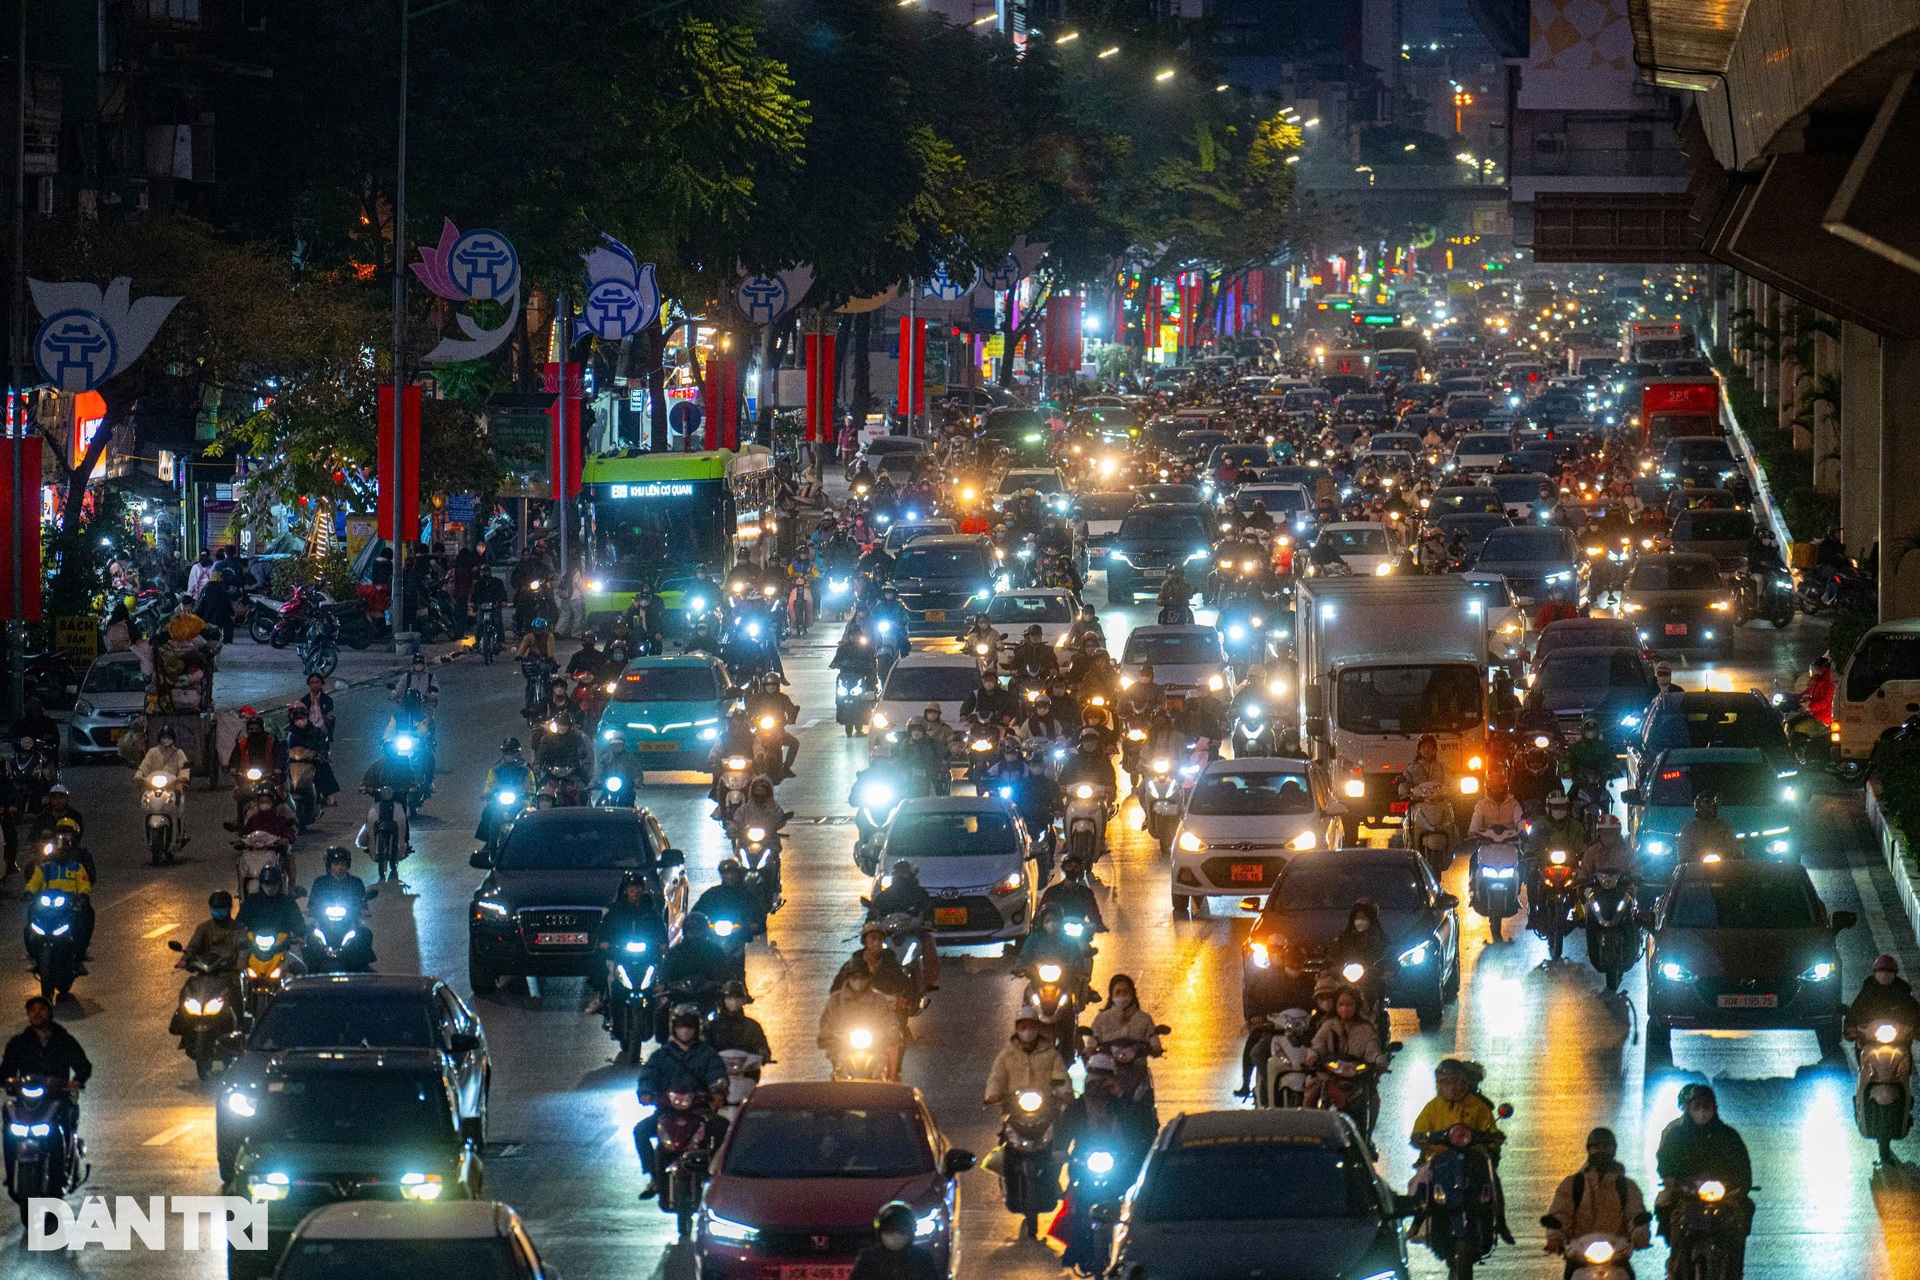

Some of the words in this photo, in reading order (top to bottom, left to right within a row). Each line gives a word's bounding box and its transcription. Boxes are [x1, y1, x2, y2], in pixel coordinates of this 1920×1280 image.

[630, 487, 644, 497] KHU
[671, 484, 692, 497] QUAN
[60, 617, 94, 631] SÁCH
[1663, 770, 1680, 779] TAXI
